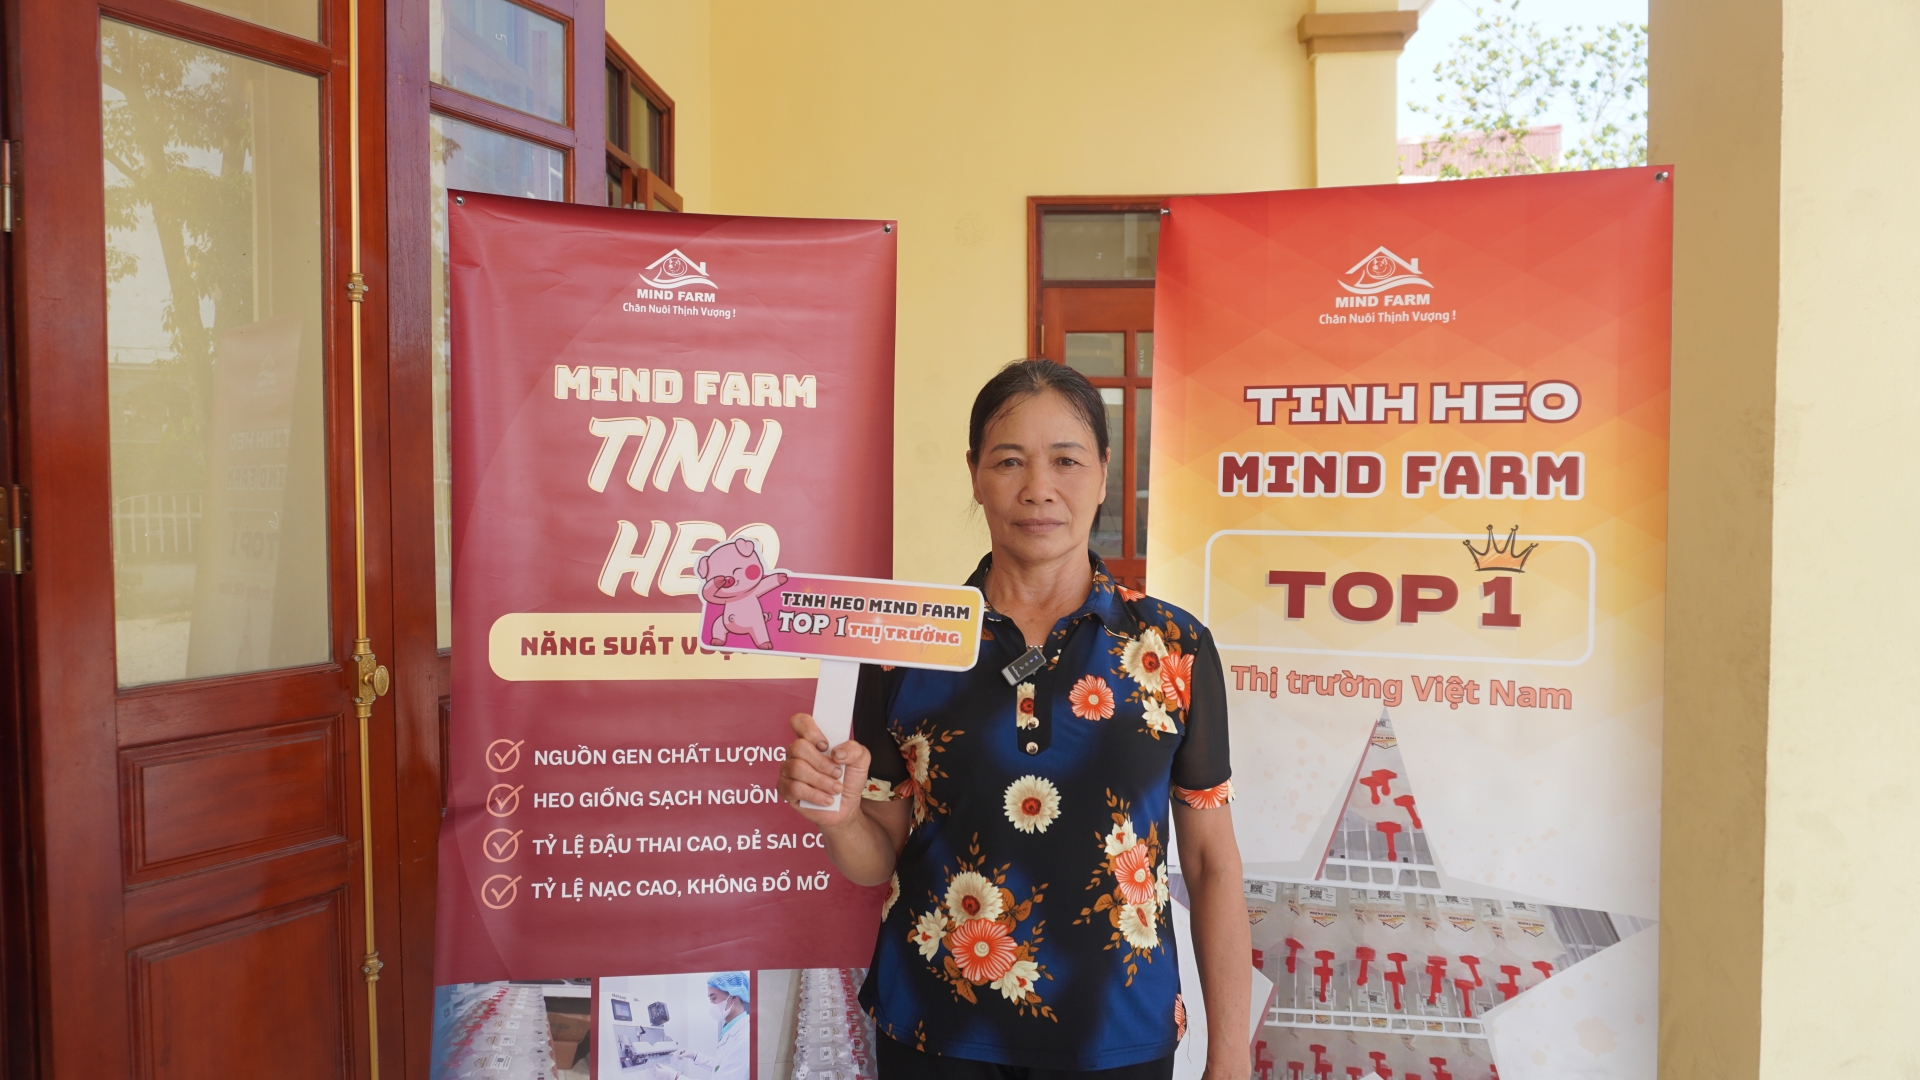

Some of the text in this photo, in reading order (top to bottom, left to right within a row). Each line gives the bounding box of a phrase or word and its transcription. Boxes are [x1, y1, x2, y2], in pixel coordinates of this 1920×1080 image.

[623, 302, 646, 314] Chăn
[648, 303, 671, 316] Nuôi
[673, 305, 699, 318] Thịnh
[700, 306, 731, 320] Vượng
[637, 289, 716, 303] MIND FARM
[1336, 293, 1430, 308] MIND FARM
[1319, 313, 1346, 325] Chăn
[1349, 311, 1375, 324] Nuôi
[1377, 310, 1409, 324] Thịnh
[1412, 310, 1449, 324] Vượng
[554, 365, 817, 408] MIND FARM
[1244, 380, 1582, 425] TINH HEO
[587, 416, 784, 496] TINH
[1218, 452, 1585, 500] MIND FARM
[781, 592, 970, 620] TINH HEO MIND FARM
[1266, 570, 1522, 629] TOP 1
[520, 630, 596, 657] NĂNG
[604, 625, 672, 656] SUẤT
[778, 610, 961, 646] TOP 1 THỊ TRƯỜNG
[1231, 665, 1572, 710] Thị trường Việt Nam
[534, 742, 786, 766] NGUỒN GEN CHẤT LƯỢNG
[533, 783, 778, 810] HEO GIỐNG SẠCH NGUỒN
[533, 835, 558, 856] TỶ
[562, 835, 585, 859] LỆ
[589, 835, 632, 858] ĐẬU
[636, 837, 682, 854] THAI
[686, 836, 733, 855] CAO,
[736, 829, 762, 850] ĐẺ
[767, 834, 798, 850] SAI
[532, 871, 830, 903] TỶ LỆ NẠC CAO, KHÔNG ĐỔ MỠ
